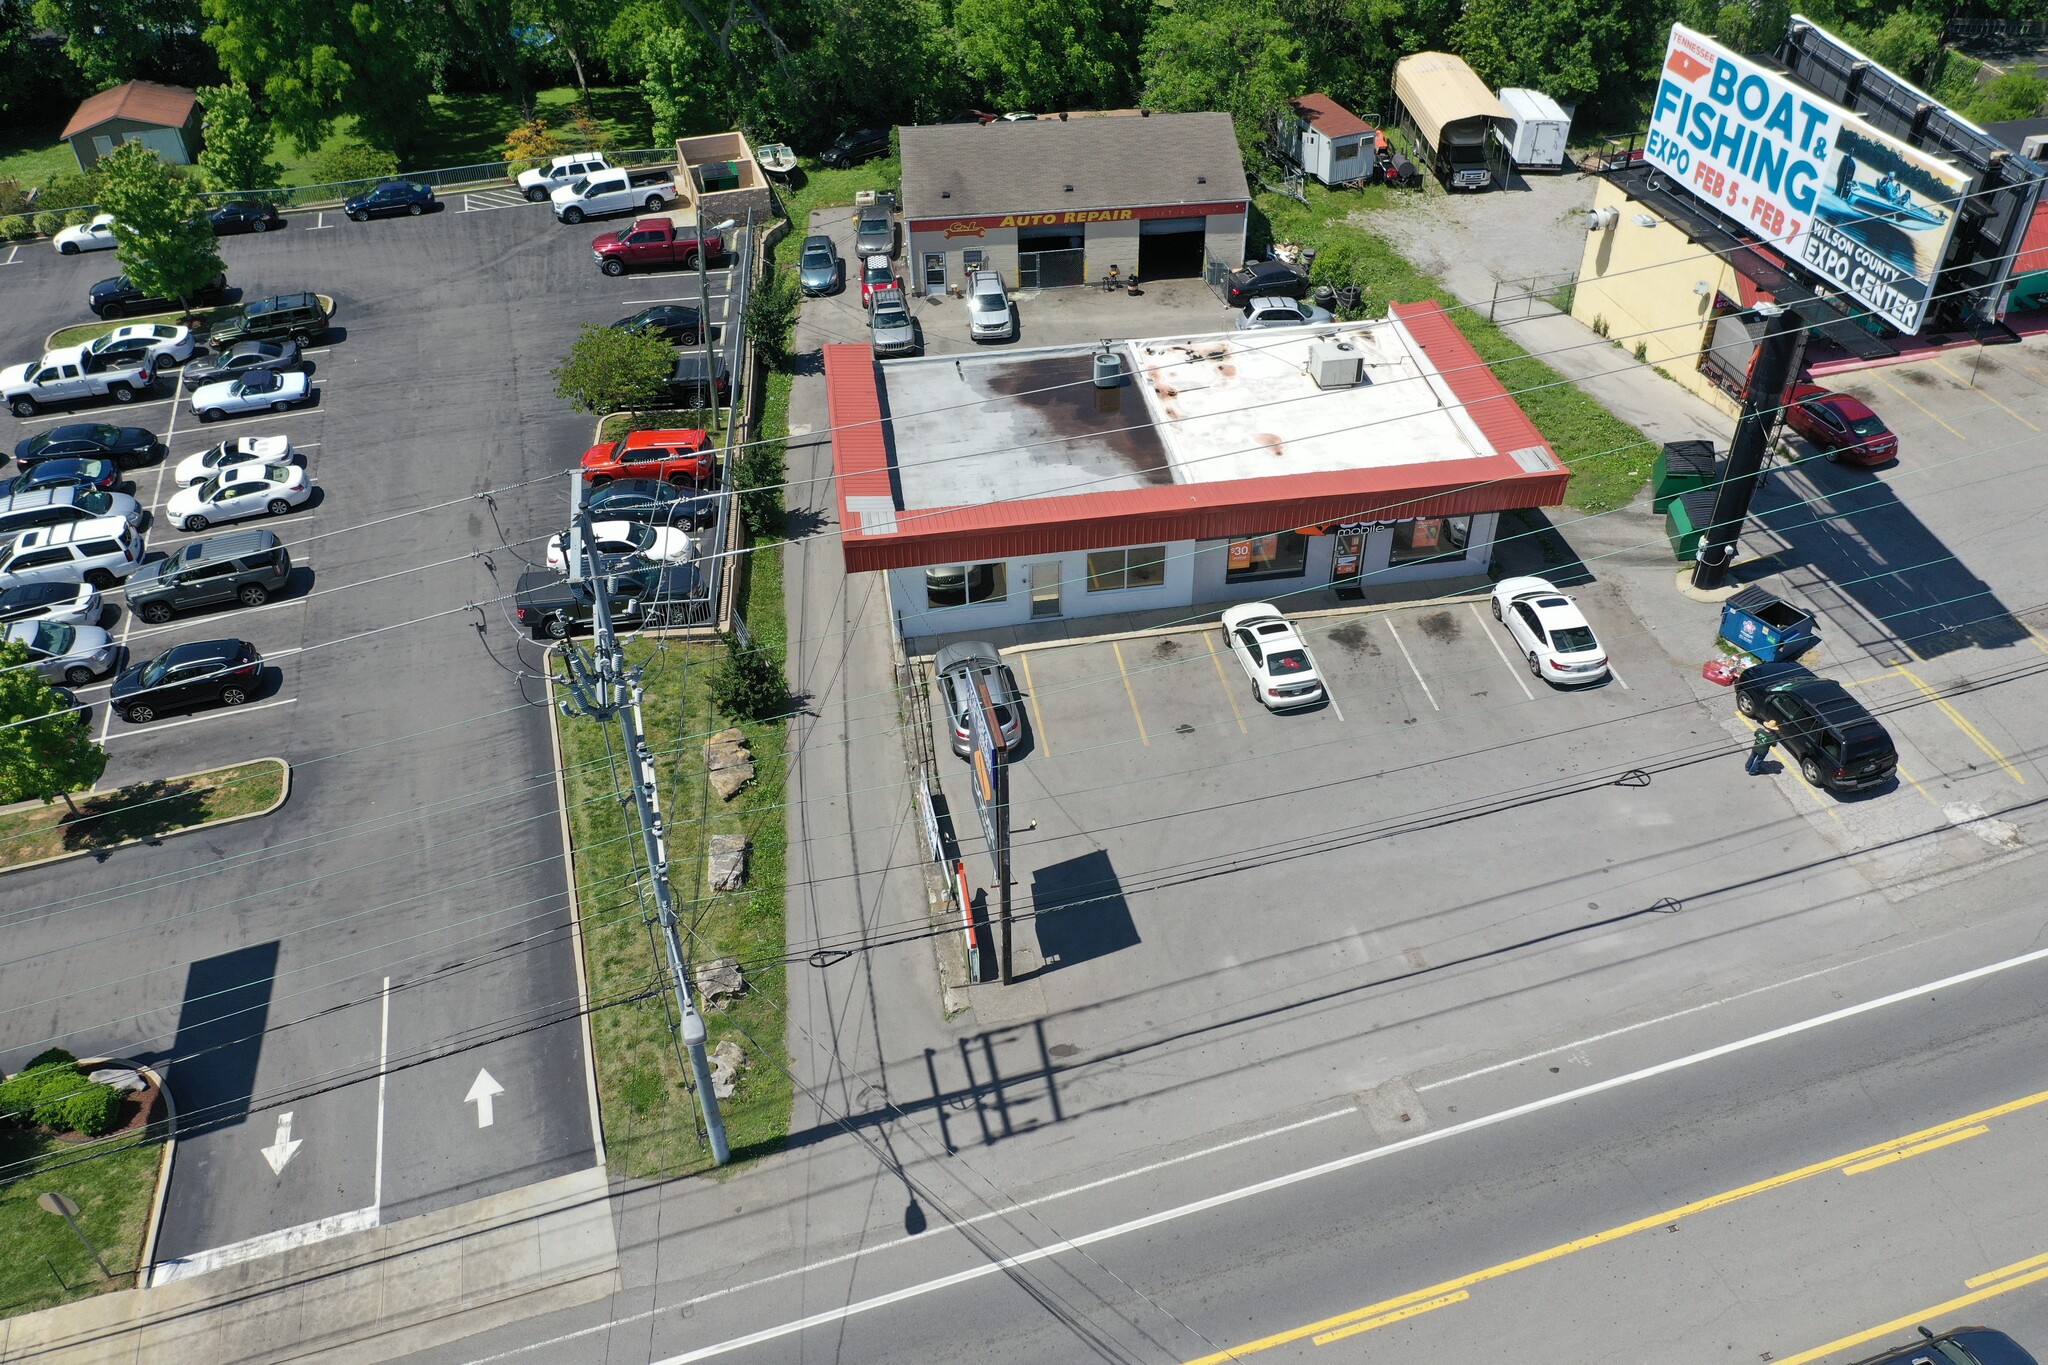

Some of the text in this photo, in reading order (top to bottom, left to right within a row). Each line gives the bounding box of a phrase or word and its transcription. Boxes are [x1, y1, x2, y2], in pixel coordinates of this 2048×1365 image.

[1673, 32, 1716, 64] TENNESSEE
[1708, 57, 1829, 162] BOAT &
[1653, 78, 1819, 216] FISHING
[1646, 128, 1690, 175] EXPO
[1693, 160, 1726, 198] FEB
[1726, 181, 1739, 207] 5
[1751, 195, 1785, 236] FEB
[1784, 219, 1801, 245] 7
[999, 209, 1132, 227] AUTO REPAIR
[1805, 236, 1918, 328] EXPO CENTER
[1813, 220, 1900, 282] WILSON COUNTY
[1230, 546, 1249, 556] $30
[1337, 524, 1385, 536] mobile
